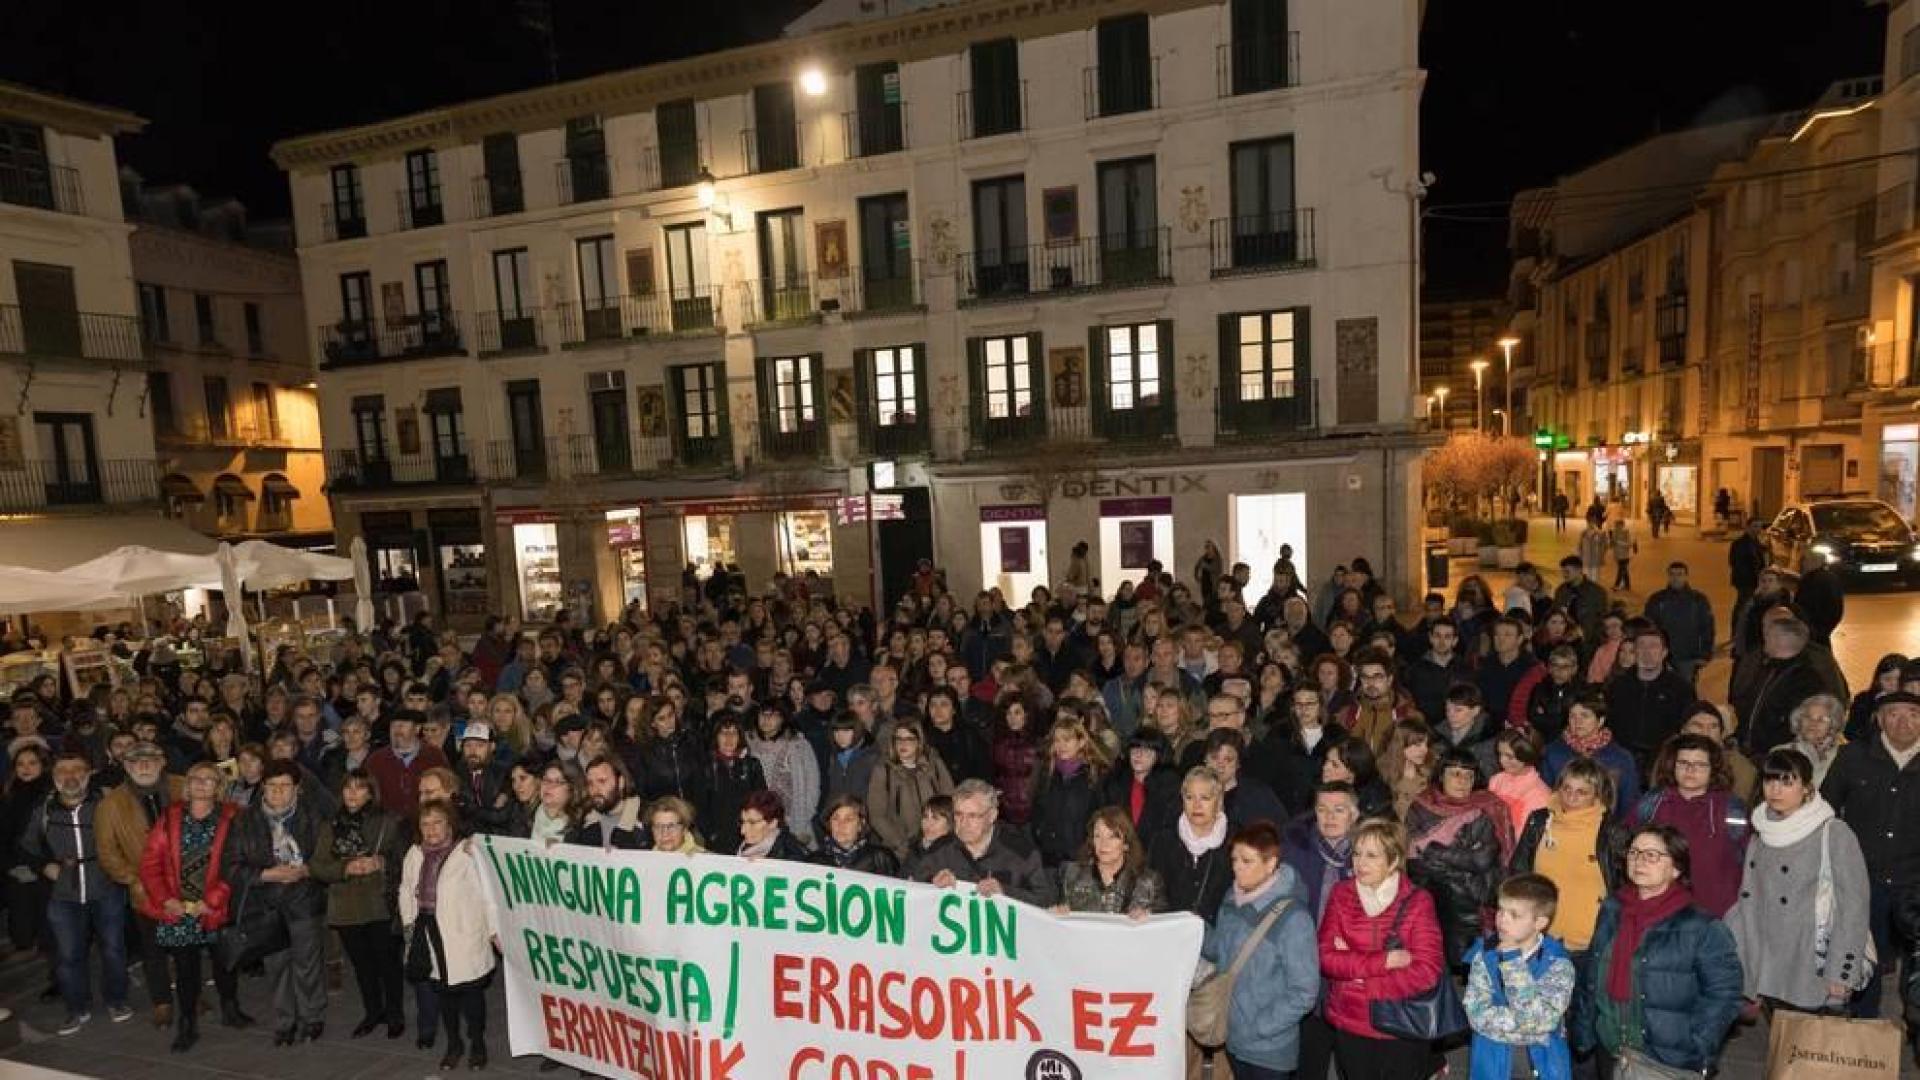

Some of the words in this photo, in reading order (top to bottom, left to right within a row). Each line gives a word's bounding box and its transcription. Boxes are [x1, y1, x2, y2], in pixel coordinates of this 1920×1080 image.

[1062, 474, 1208, 498] DENTIX
[666, 868, 907, 946] AGRESION
[930, 890, 1018, 961] SIN
[540, 993, 746, 1080] ERANTZUNIK
[773, 953, 1042, 1043] ERASORIK
[1071, 988, 1159, 1057] EZ
